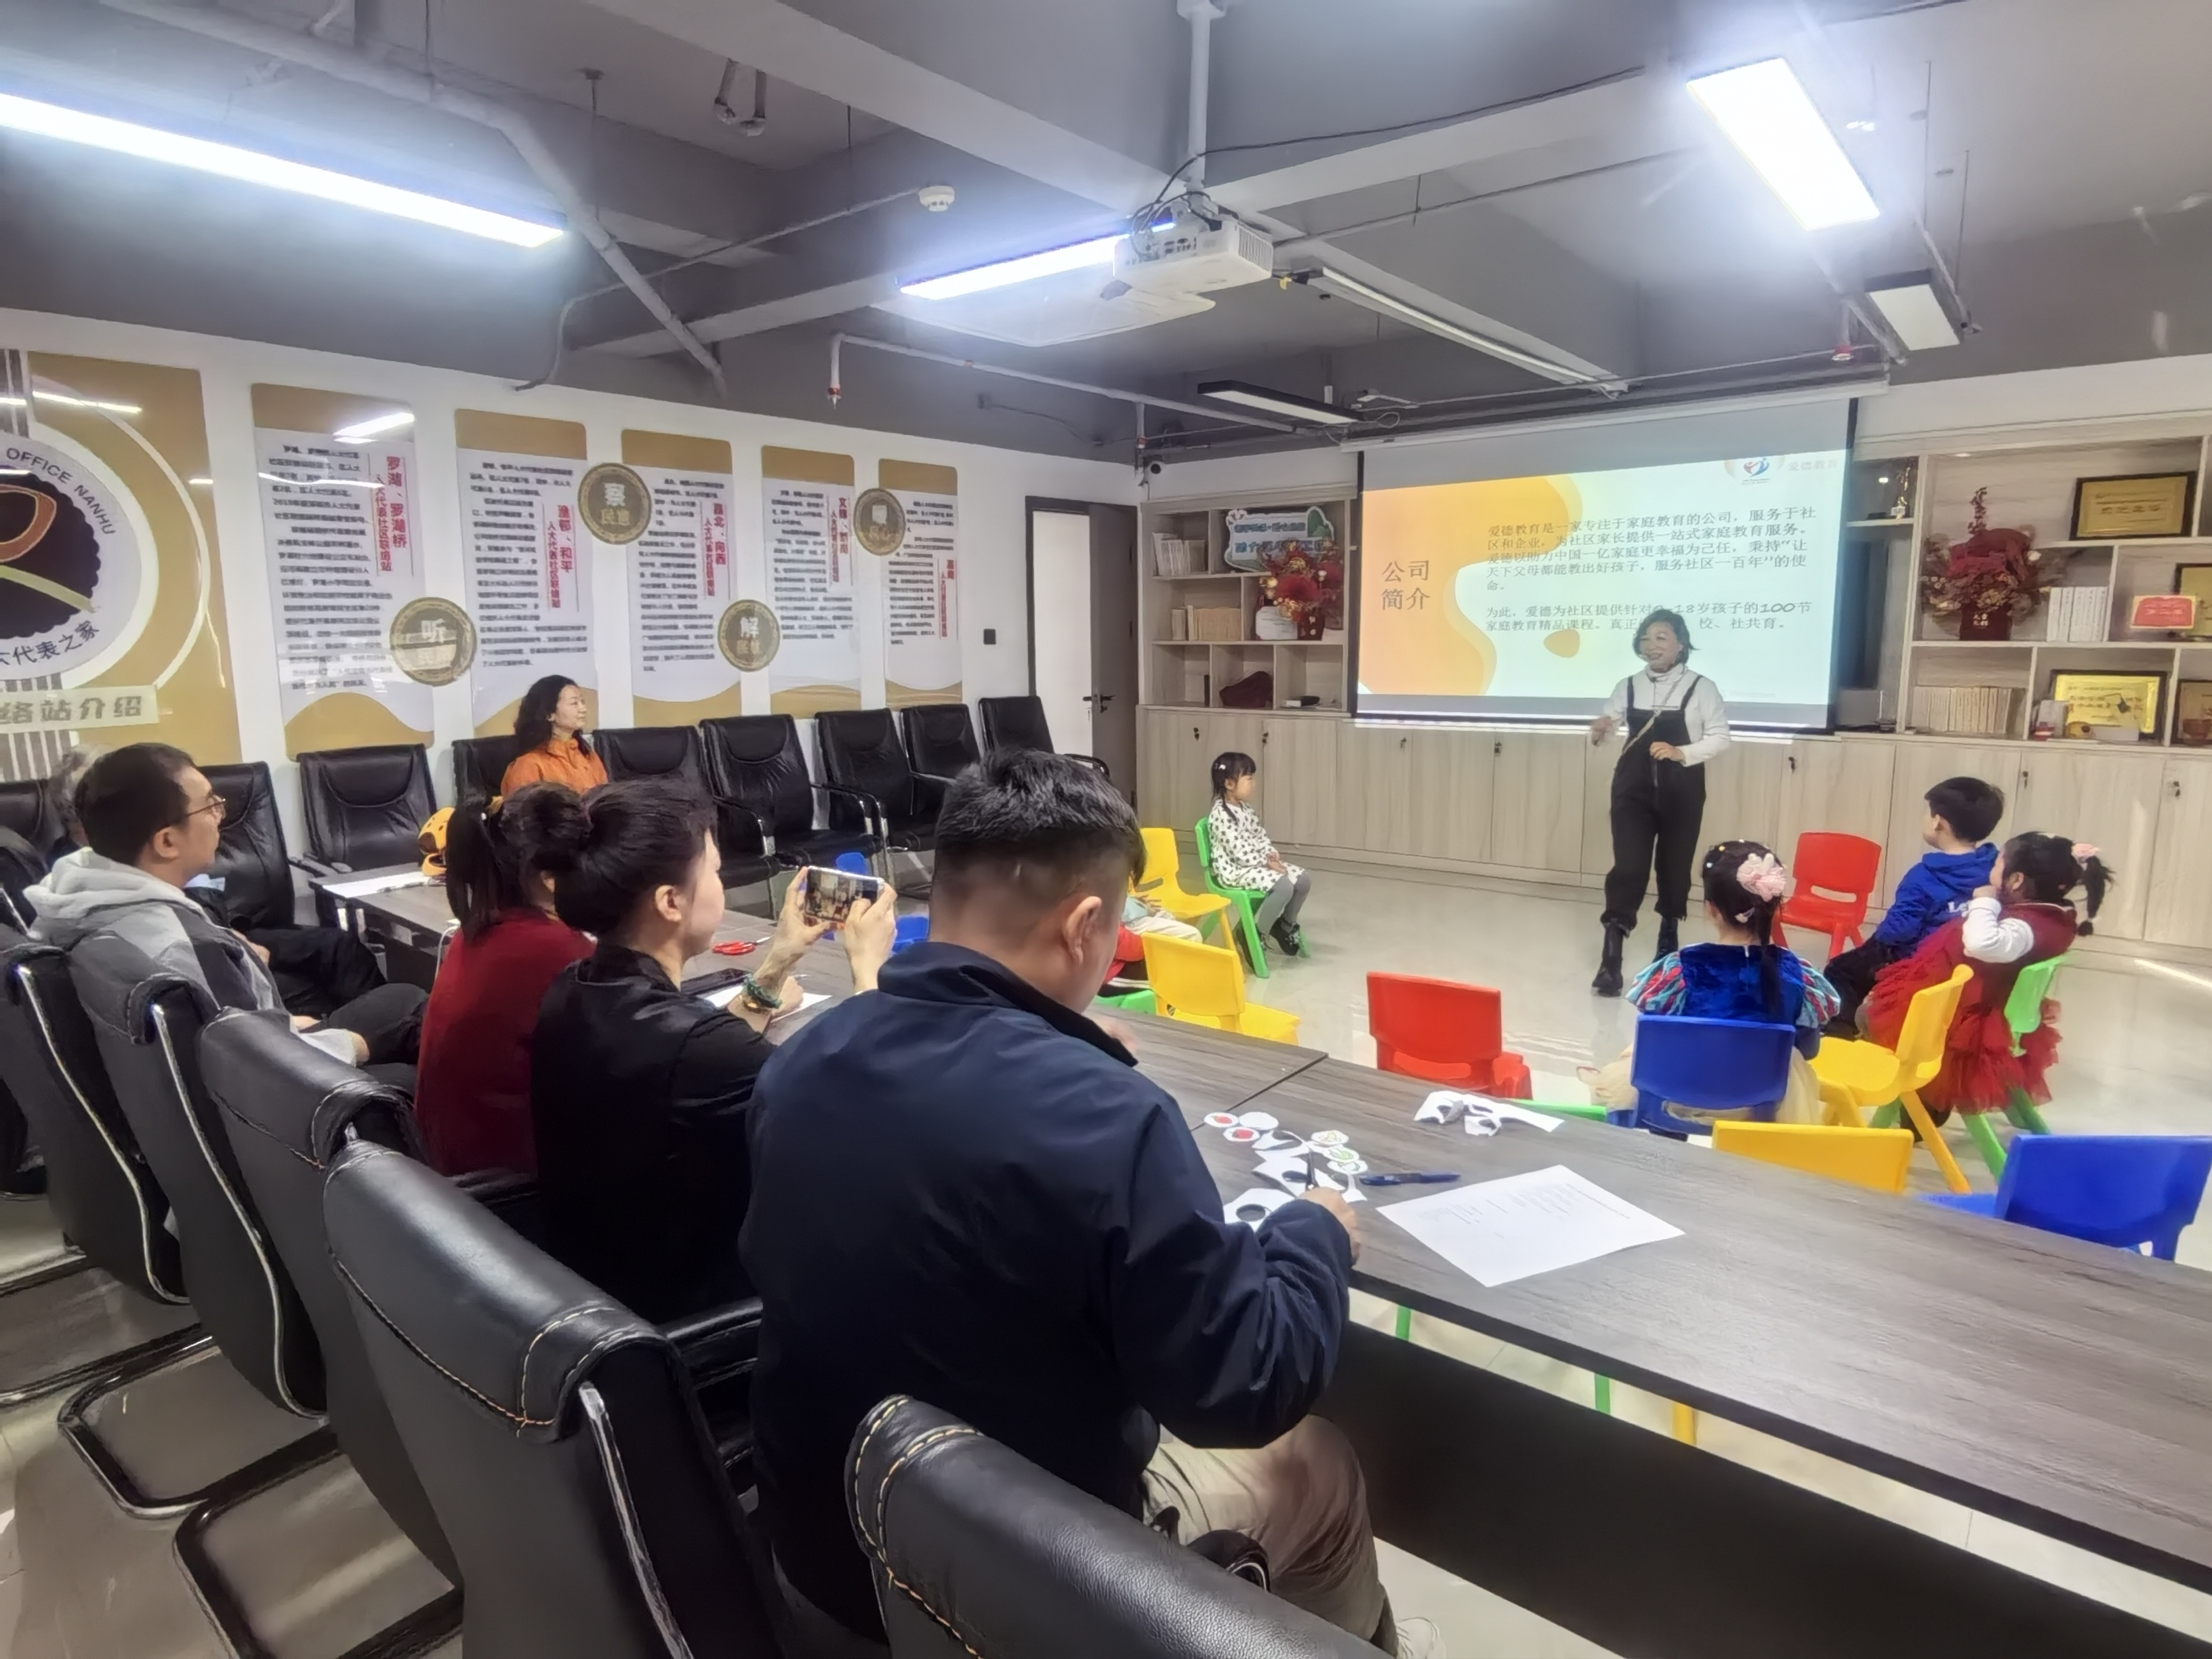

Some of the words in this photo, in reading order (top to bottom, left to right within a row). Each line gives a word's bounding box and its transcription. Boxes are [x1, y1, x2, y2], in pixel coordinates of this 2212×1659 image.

[7, 447, 74, 485] OFFICE
[74, 485, 116, 535] NANHU
[1381, 560, 1430, 583] 公司
[1381, 587, 1431, 611] 简介
